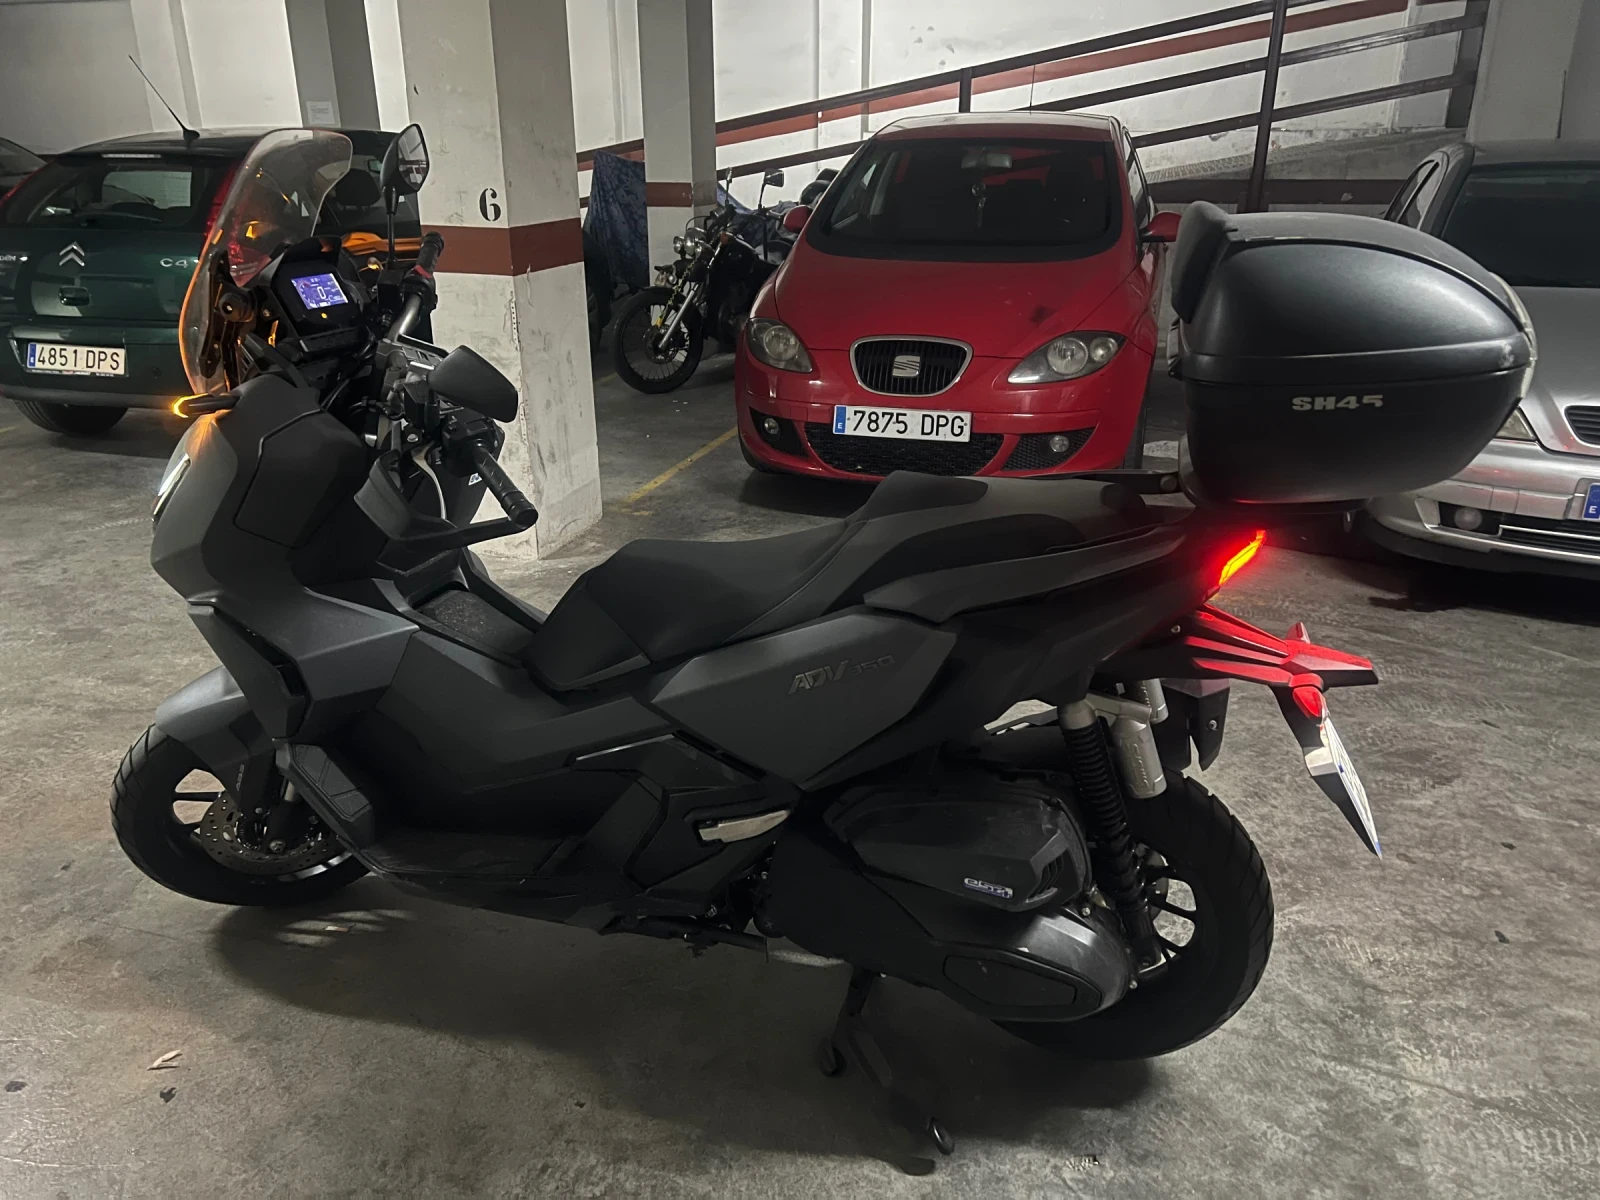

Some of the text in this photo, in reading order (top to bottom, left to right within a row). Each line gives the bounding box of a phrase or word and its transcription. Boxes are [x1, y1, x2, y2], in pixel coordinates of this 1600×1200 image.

[479, 187, 502, 222] 6
[160, 258, 189, 269] C4
[37, 346, 120, 370] 4851 DPS
[853, 410, 965, 438] 7875 DPG
[1588, 505, 1598, 514] E
[787, 654, 896, 695] ADV 350
